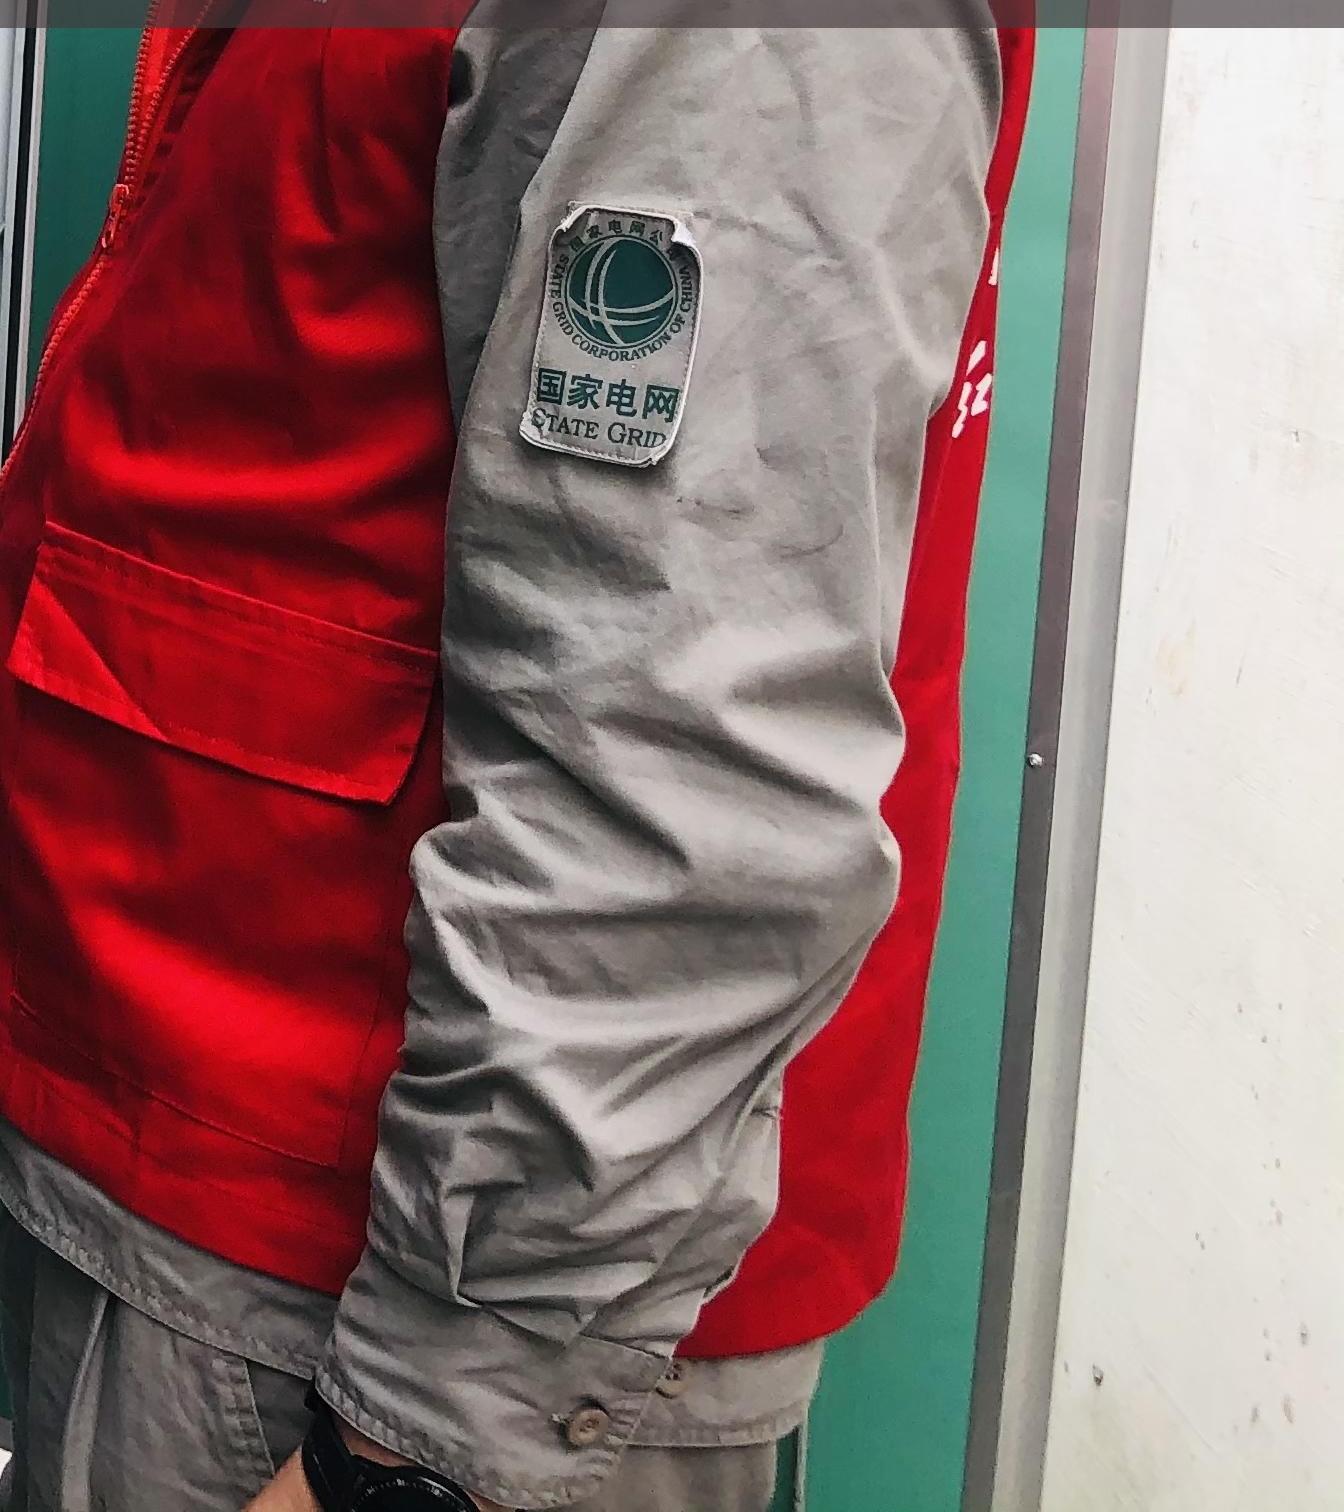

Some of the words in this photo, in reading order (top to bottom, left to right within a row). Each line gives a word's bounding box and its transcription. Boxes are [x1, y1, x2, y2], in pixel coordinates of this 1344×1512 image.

[551, 299, 575, 337] GRID
[570, 328, 674, 362] CORPORATION
[669, 315, 687, 335] OF
[536, 367, 681, 423] 国家电网
[530, 407, 600, 440] STATE
[607, 421, 668, 449] GRID
